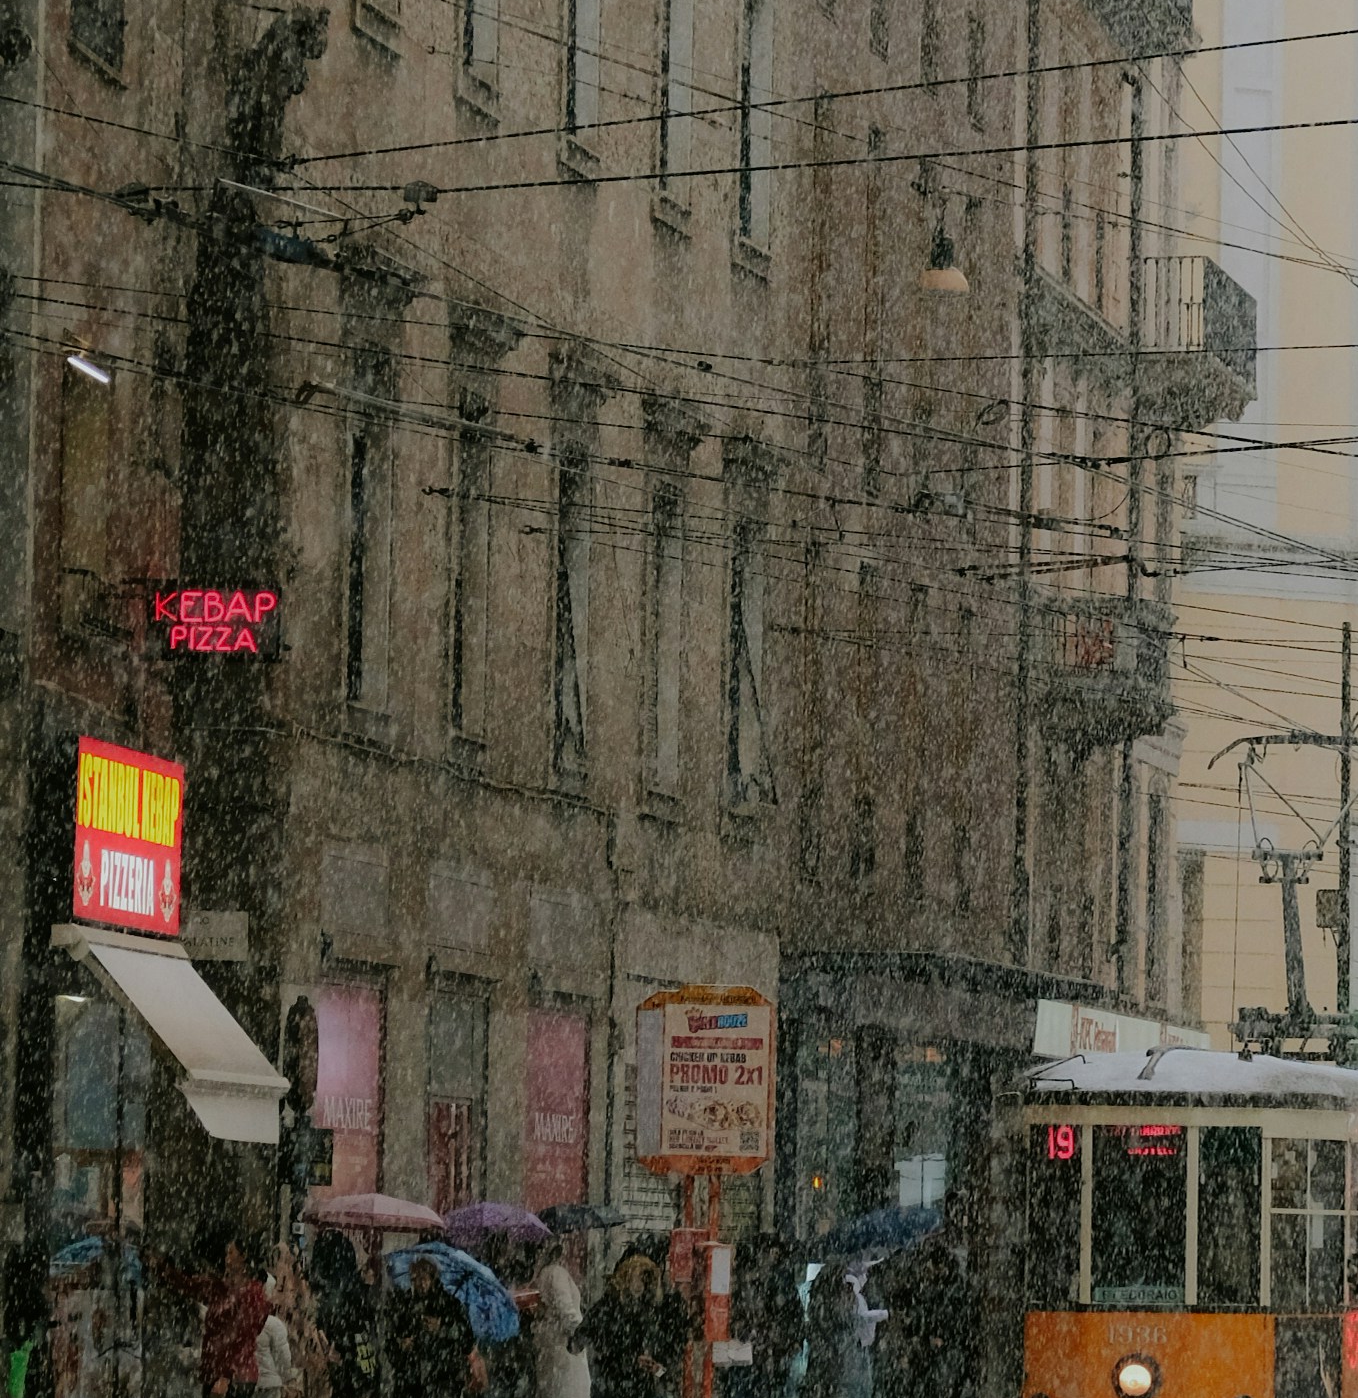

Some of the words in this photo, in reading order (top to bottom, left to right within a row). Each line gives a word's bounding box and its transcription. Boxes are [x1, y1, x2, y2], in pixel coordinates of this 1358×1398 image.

[155, 589, 277, 623] KEBAP
[170, 625, 257, 653] PIZZA
[77, 752, 140, 840] ISTANBUL
[141, 769, 181, 848] KEBAP
[99, 848, 156, 917] PIZZERIA
[669, 1064, 729, 1086] PROMO
[734, 1065, 764, 1087] 2x1
[322, 1095, 373, 1131] MAXIRE
[532, 1112, 578, 1144] MAXIRE
[1047, 1124, 1075, 1161] 19
[1108, 1324, 1168, 1345] 1936
